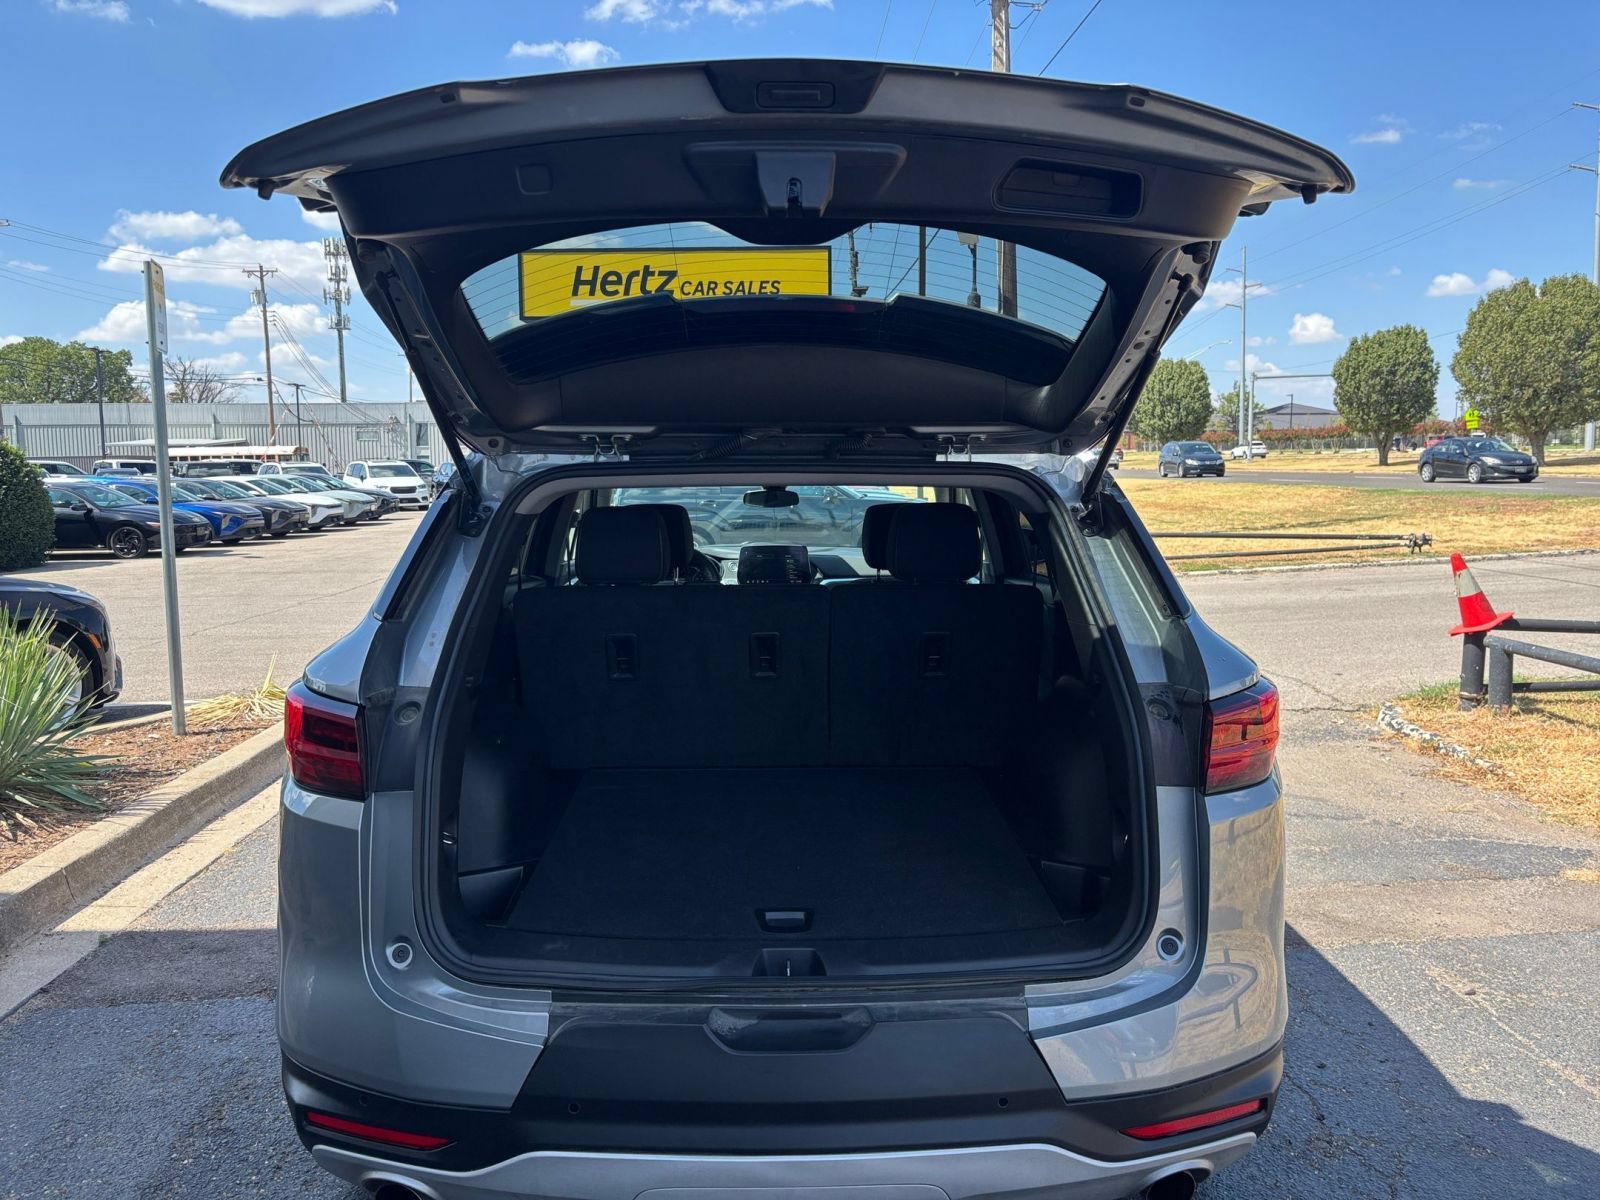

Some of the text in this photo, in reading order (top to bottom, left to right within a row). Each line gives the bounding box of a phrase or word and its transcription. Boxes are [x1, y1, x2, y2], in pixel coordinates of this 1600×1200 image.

[571, 265, 781, 296] Hertz CAR SALES
